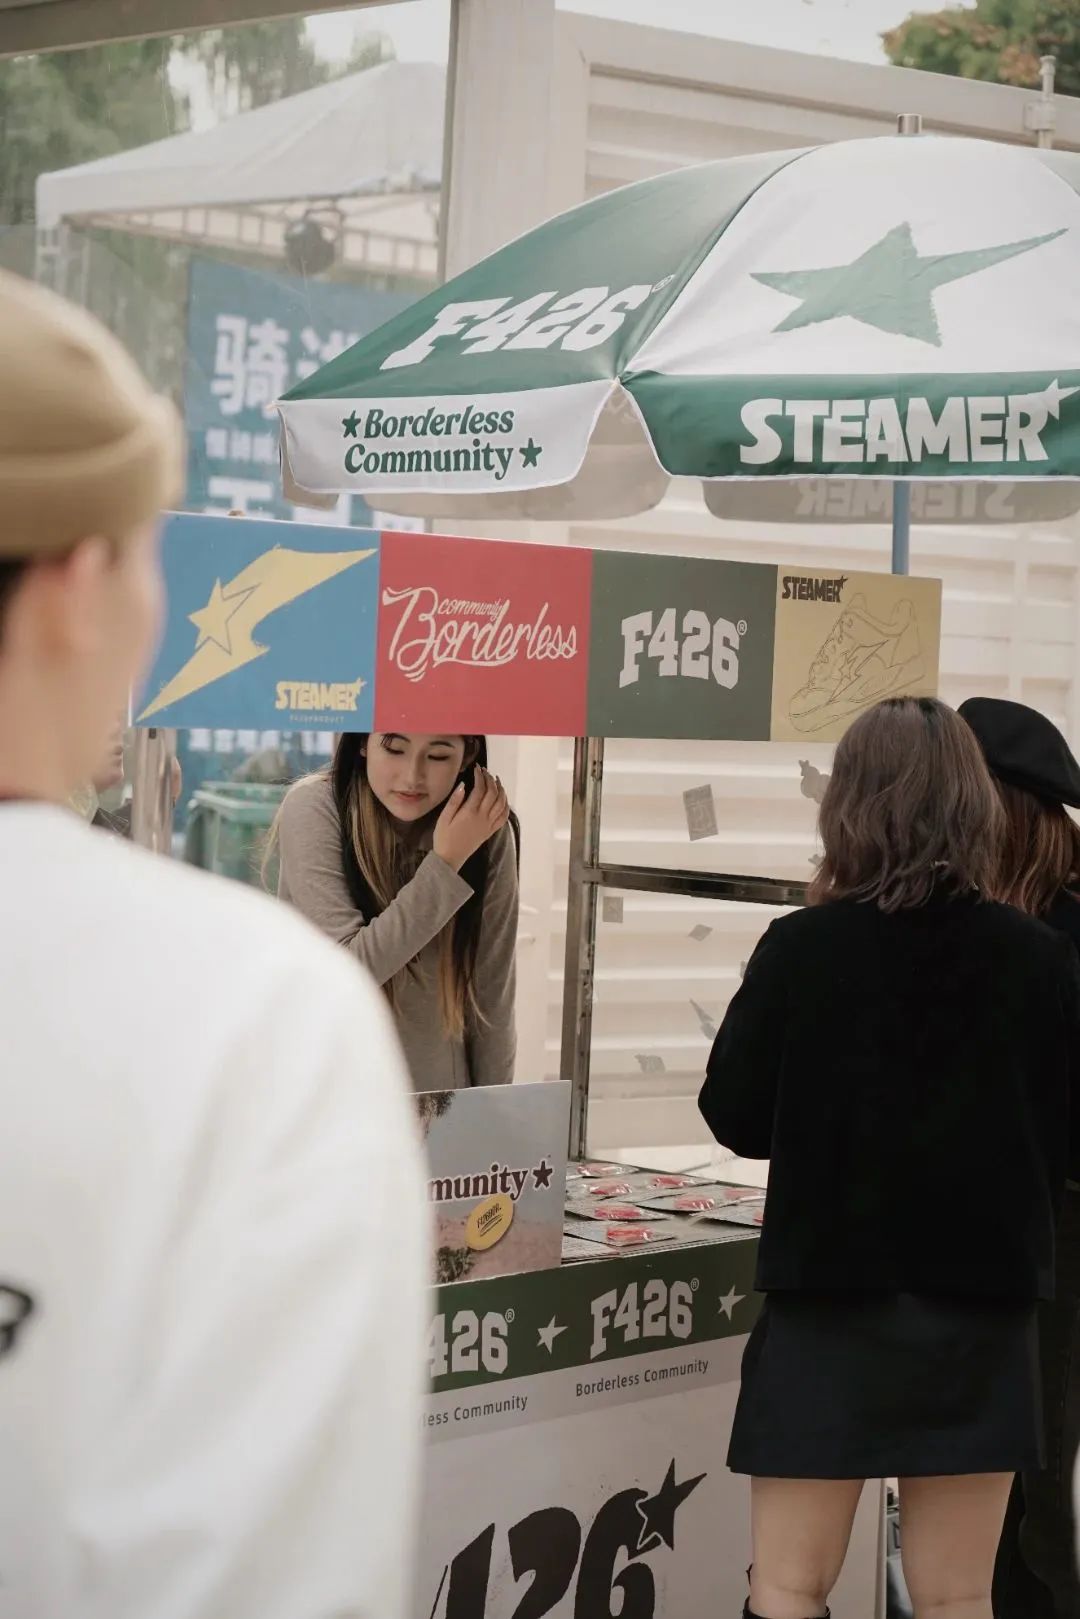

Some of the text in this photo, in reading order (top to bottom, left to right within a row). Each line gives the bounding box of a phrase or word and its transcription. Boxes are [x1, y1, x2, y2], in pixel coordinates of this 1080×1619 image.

[363, 405, 515, 439] Borderless
[739, 394, 1050, 465] STEAMER
[344, 438, 515, 481] Community
[782, 574, 847, 603] STEAMER
[382, 586, 578, 682] Borderless
[275, 679, 361, 711] STEAMER
[430, 1163, 529, 1201] munity
[576, 1358, 710, 1397] Borderless Community
[453, 1395, 528, 1421] Community
